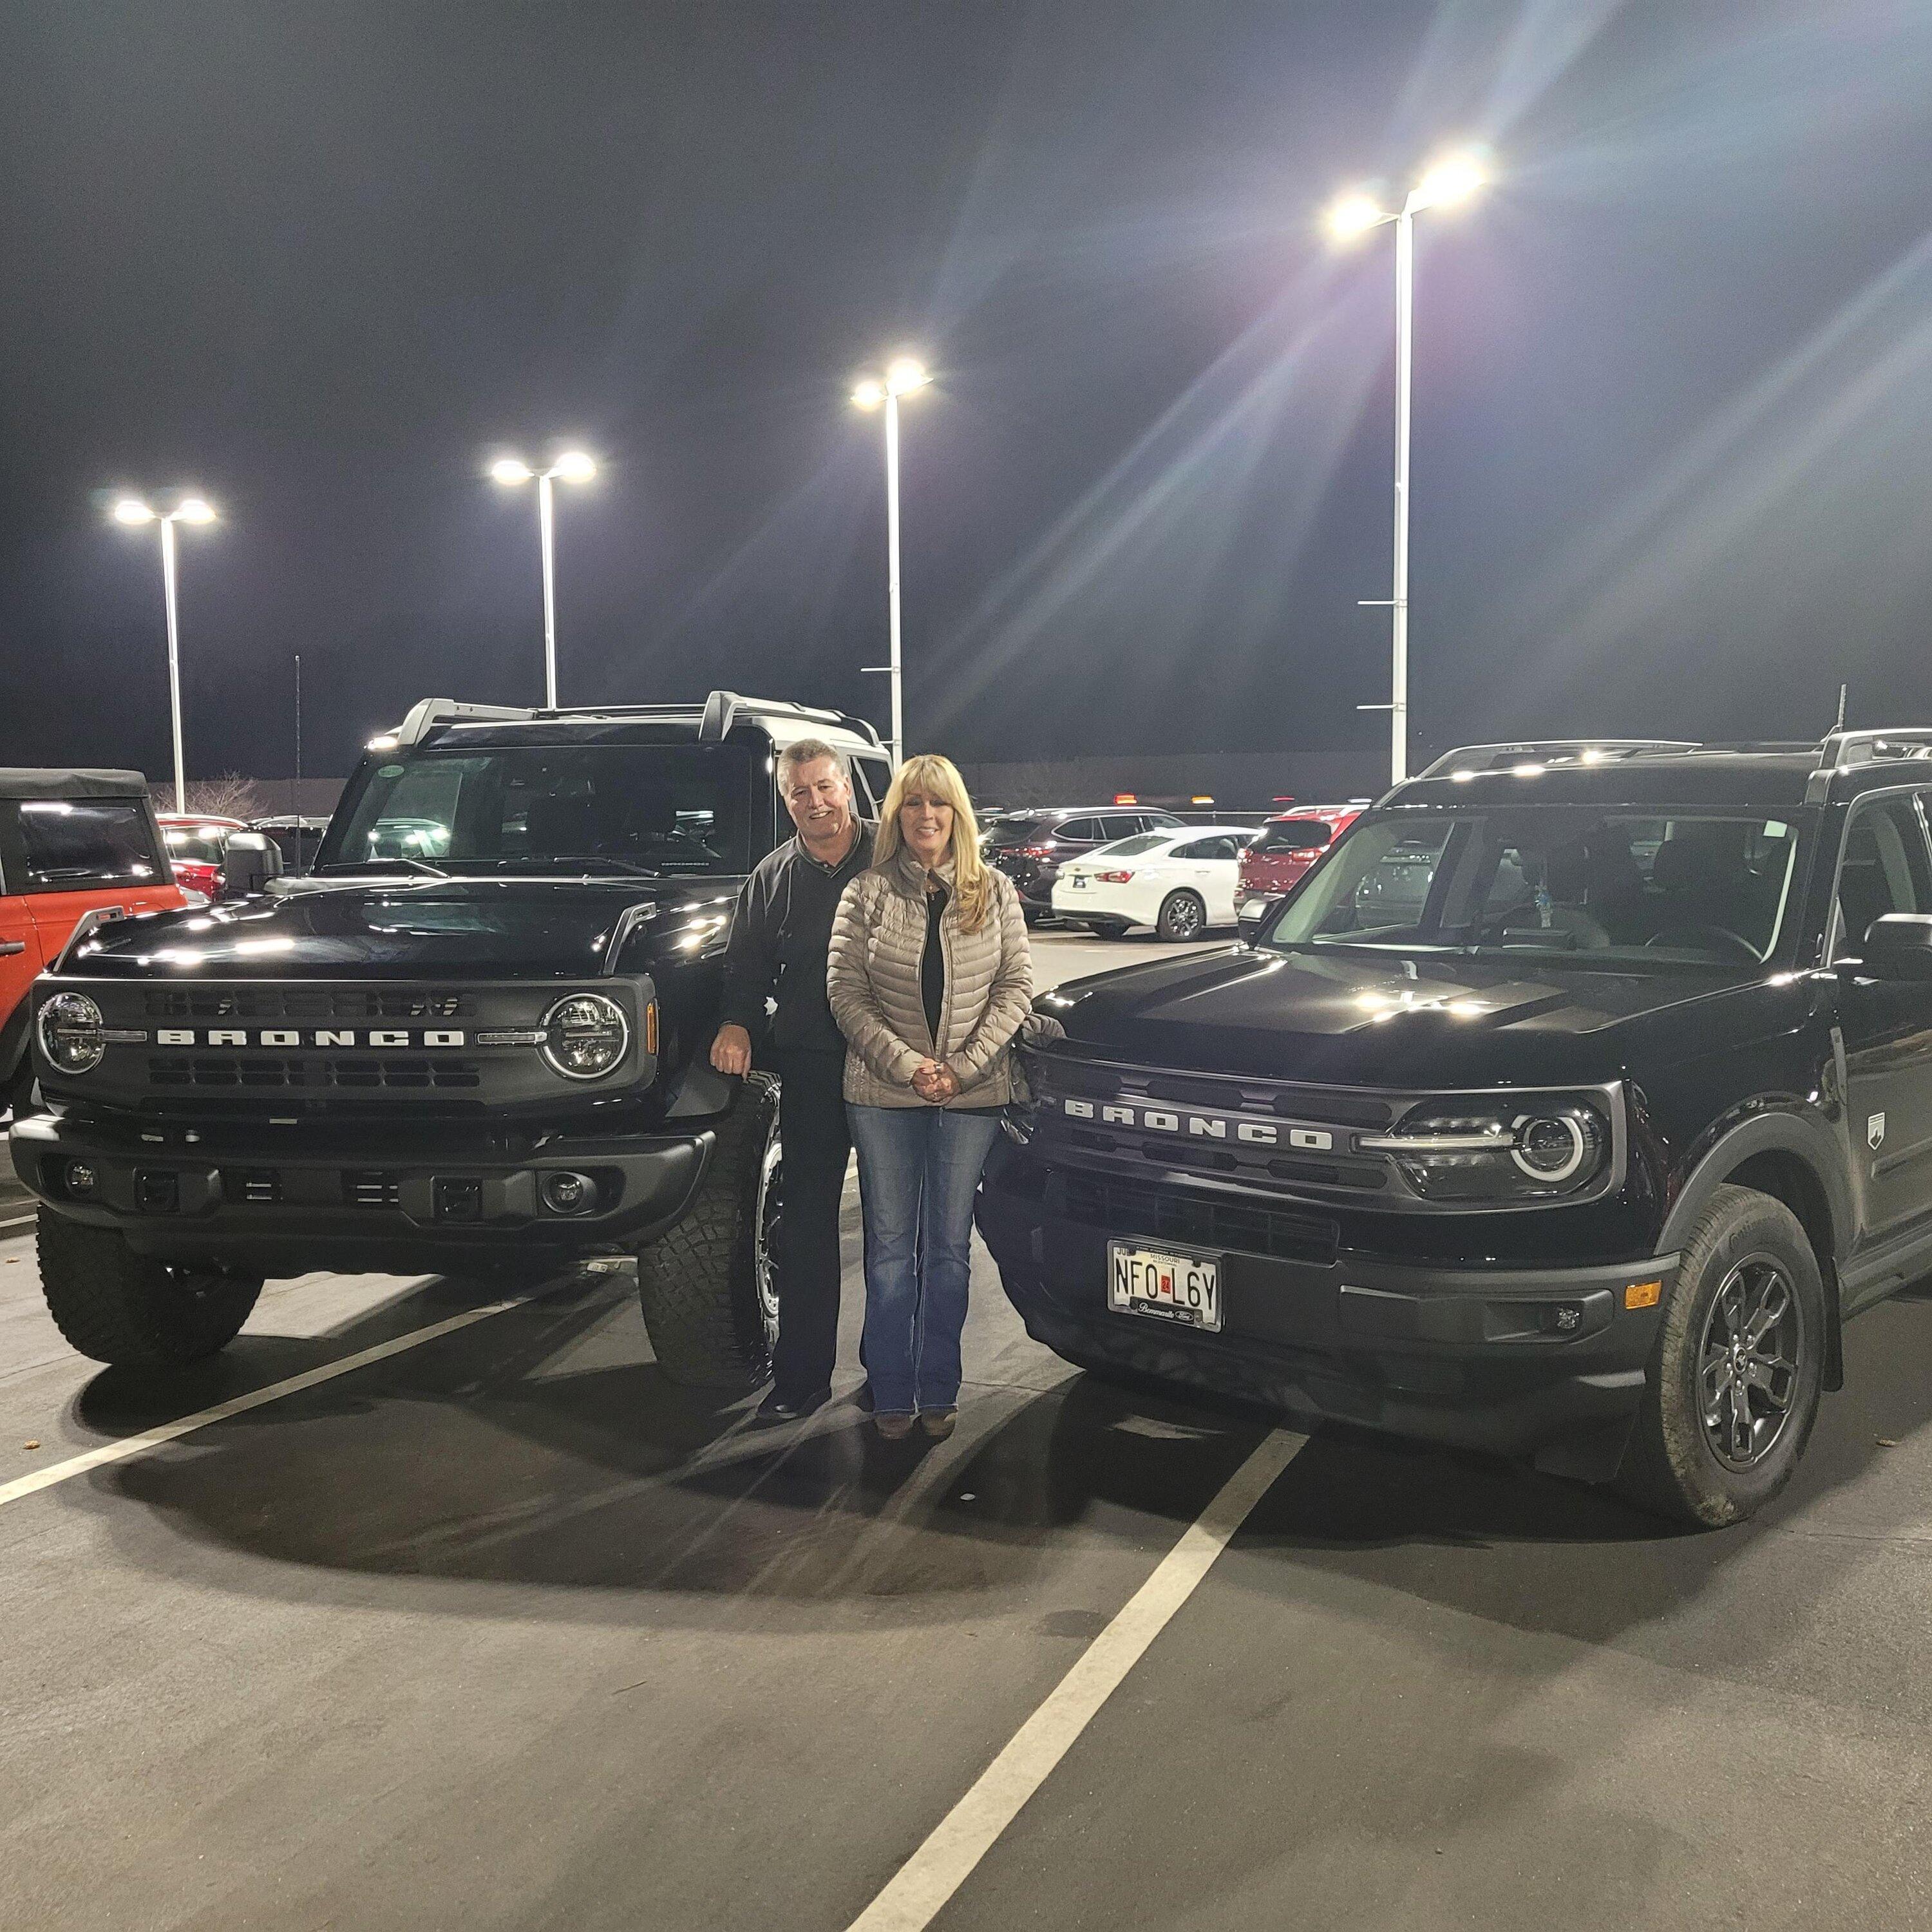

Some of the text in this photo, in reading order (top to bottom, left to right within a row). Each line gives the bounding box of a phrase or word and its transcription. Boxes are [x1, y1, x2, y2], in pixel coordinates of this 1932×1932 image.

[157, 1030, 464, 1046] BRONCO
[1065, 1099, 1332, 1150] BRONCO
[1150, 1254, 1180, 1264] MISSOURI
[1171, 1268, 1215, 1310] L6Y
